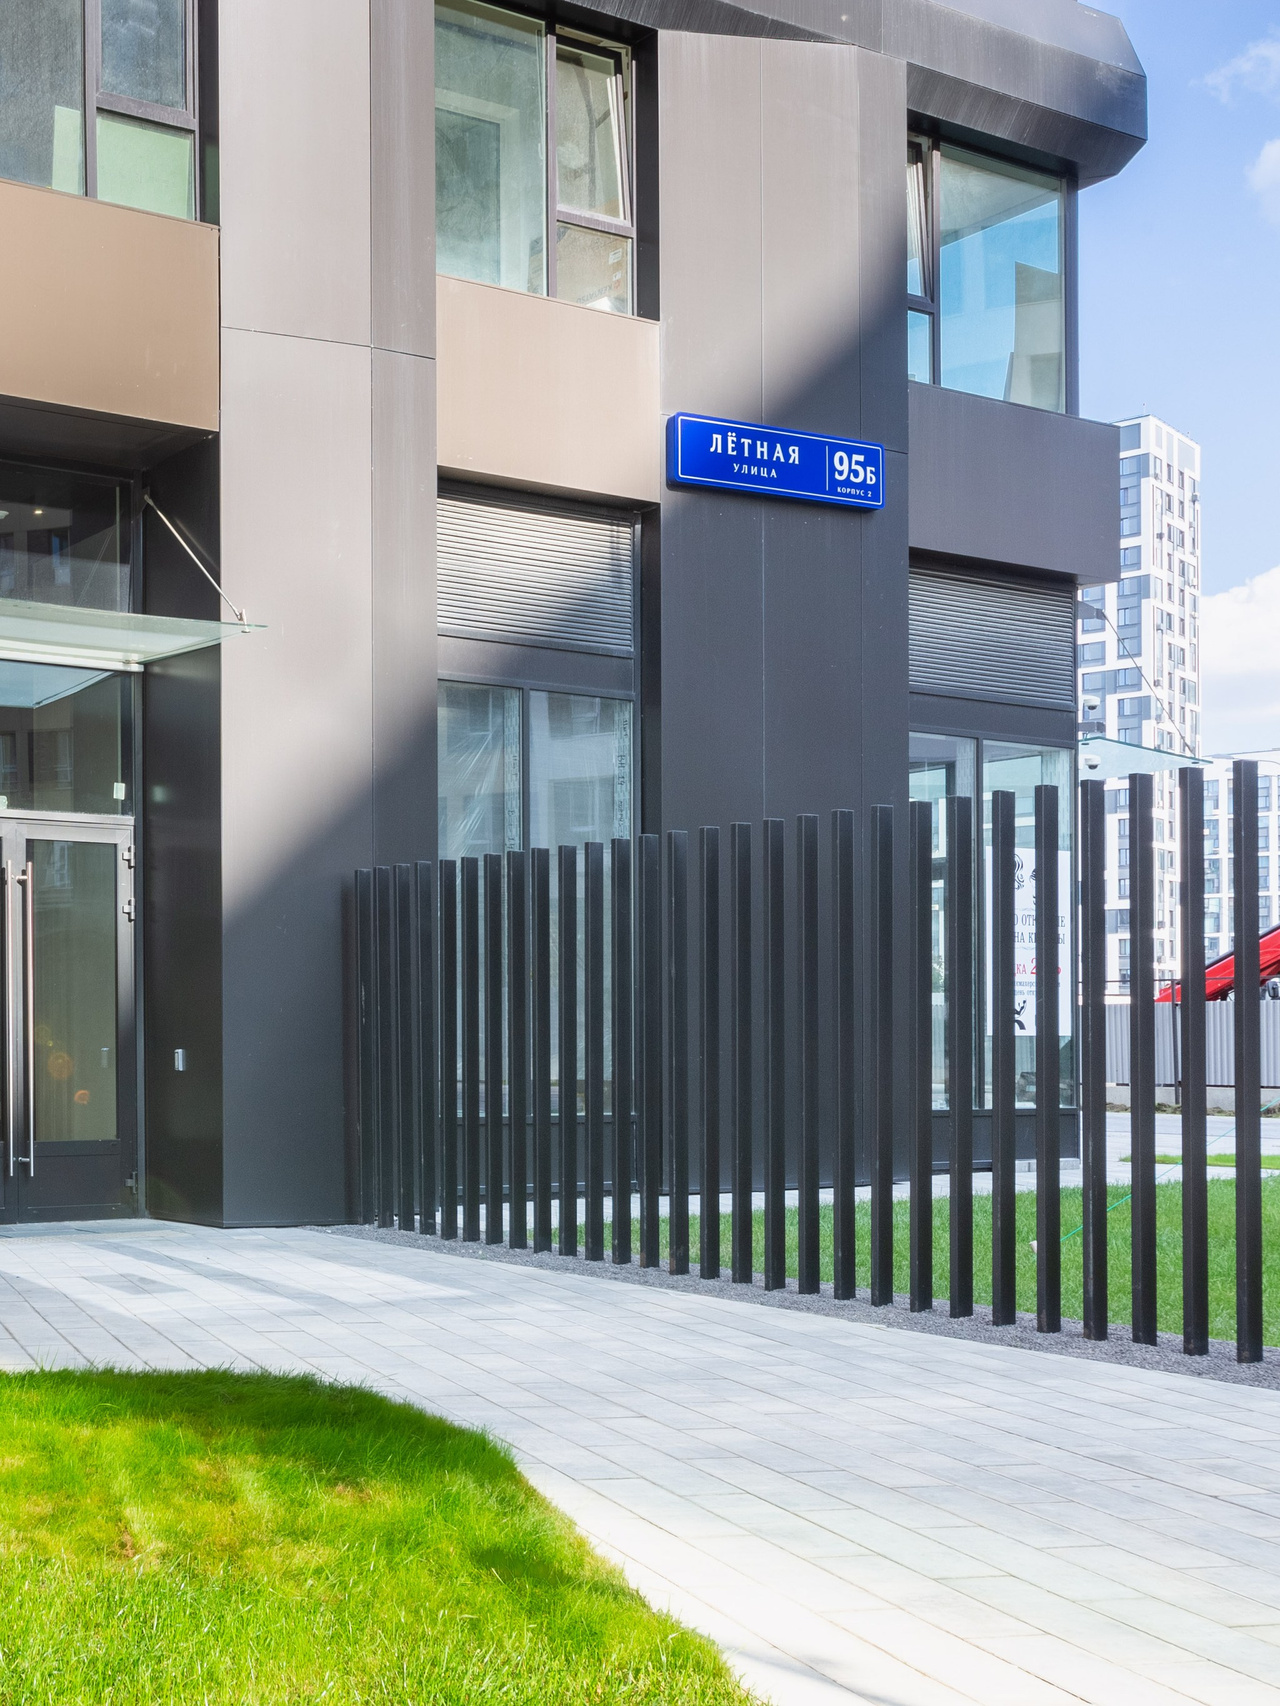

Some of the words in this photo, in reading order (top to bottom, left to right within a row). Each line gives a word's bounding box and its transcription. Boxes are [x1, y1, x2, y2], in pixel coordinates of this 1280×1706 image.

[710, 432, 799, 464] ЛЁТНАЯ
[733, 463, 777, 478] УЛИЦА
[833, 451, 876, 485] 95Б
[837, 486, 865, 497] КОРПУС
